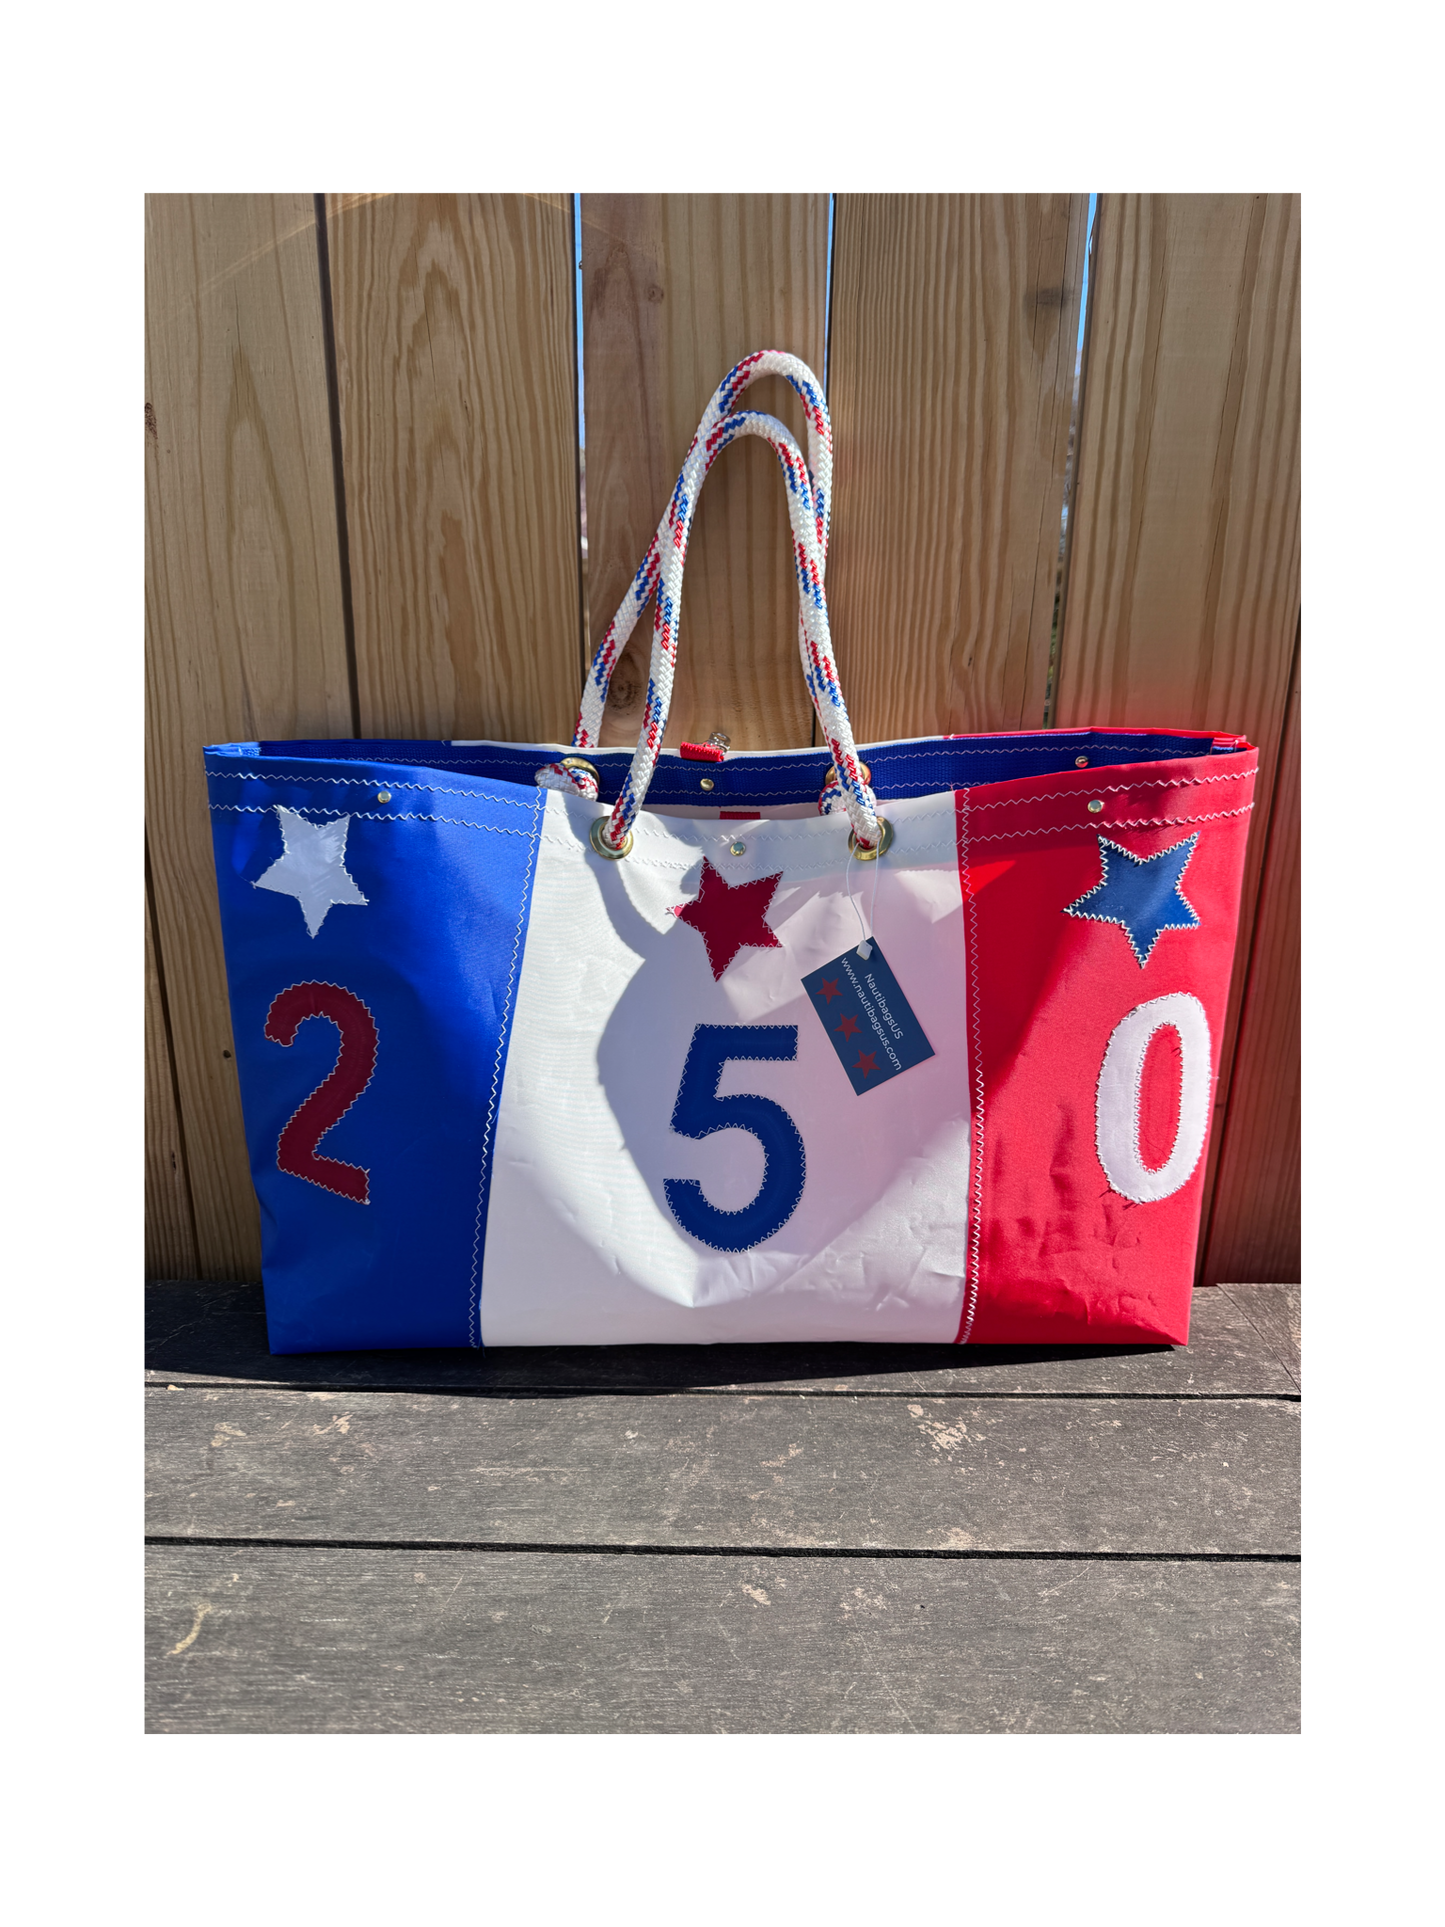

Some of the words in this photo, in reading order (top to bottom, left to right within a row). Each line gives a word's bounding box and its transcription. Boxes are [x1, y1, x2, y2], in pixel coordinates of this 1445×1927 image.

[841, 957, 902, 1071] www.nautibagsus.com
[864, 973, 904, 1040] NautibagsUS
[264, 980, 380, 1205] 2
[663, 1023, 807, 1254] 5
